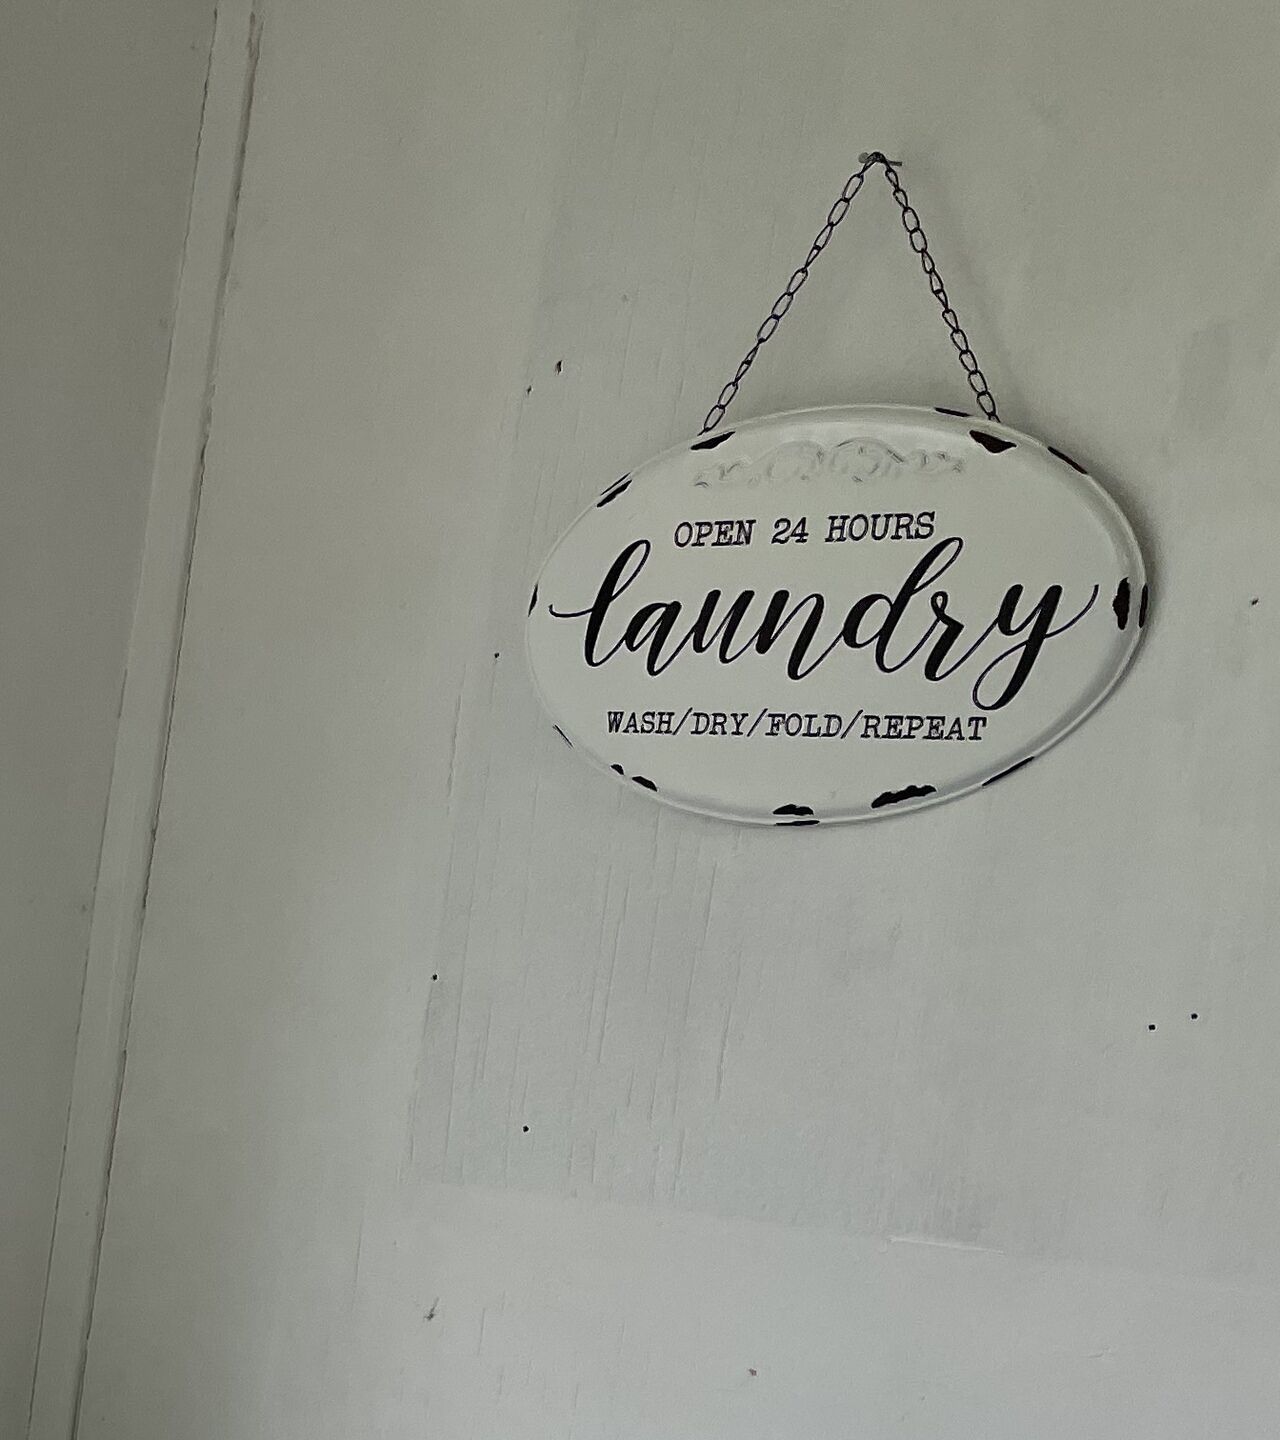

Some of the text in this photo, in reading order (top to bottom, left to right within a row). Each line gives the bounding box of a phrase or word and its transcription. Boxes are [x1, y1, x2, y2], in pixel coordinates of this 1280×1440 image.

[674, 511, 937, 548] OPEN 24 HOURS
[548, 537, 1100, 711] laundry
[606, 709, 988, 743] WASH/DRY/FOLD/REPEAT
